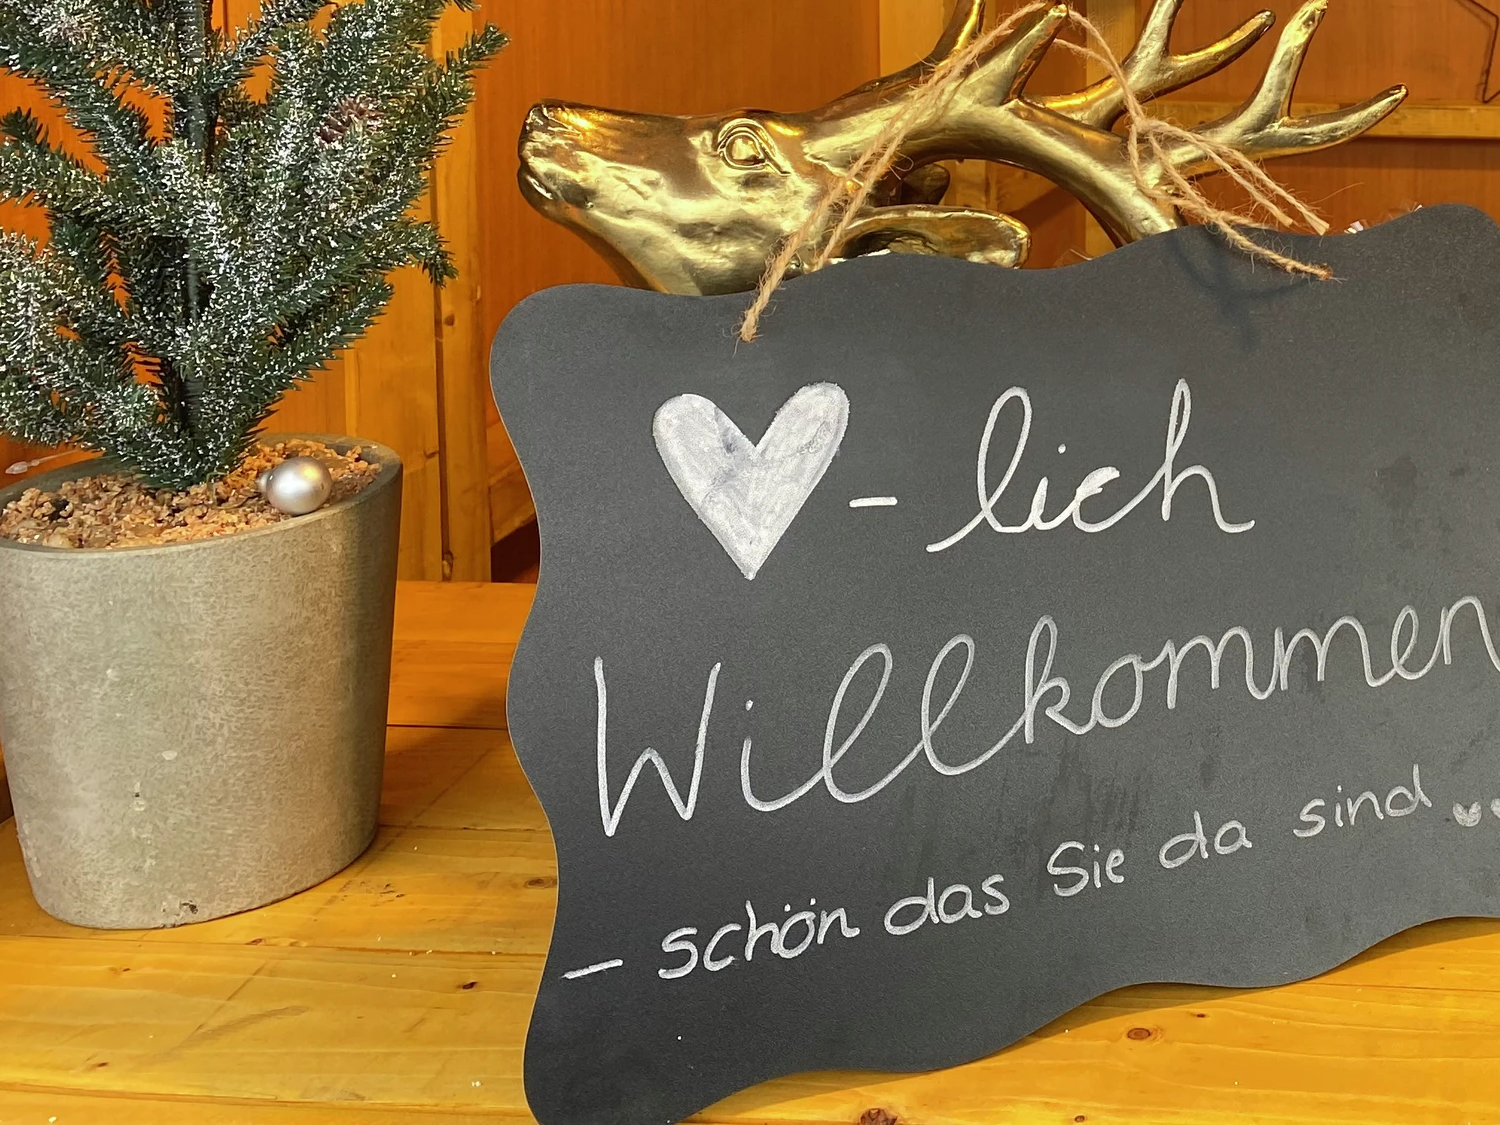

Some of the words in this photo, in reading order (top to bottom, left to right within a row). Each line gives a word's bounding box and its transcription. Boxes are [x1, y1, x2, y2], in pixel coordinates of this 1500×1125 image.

[657, 899, 861, 981] schön
[883, 873, 1011, 936] das
[1046, 840, 1126, 897] Sie
[1158, 810, 1254, 869] da
[1292, 763, 1434, 838] sind
